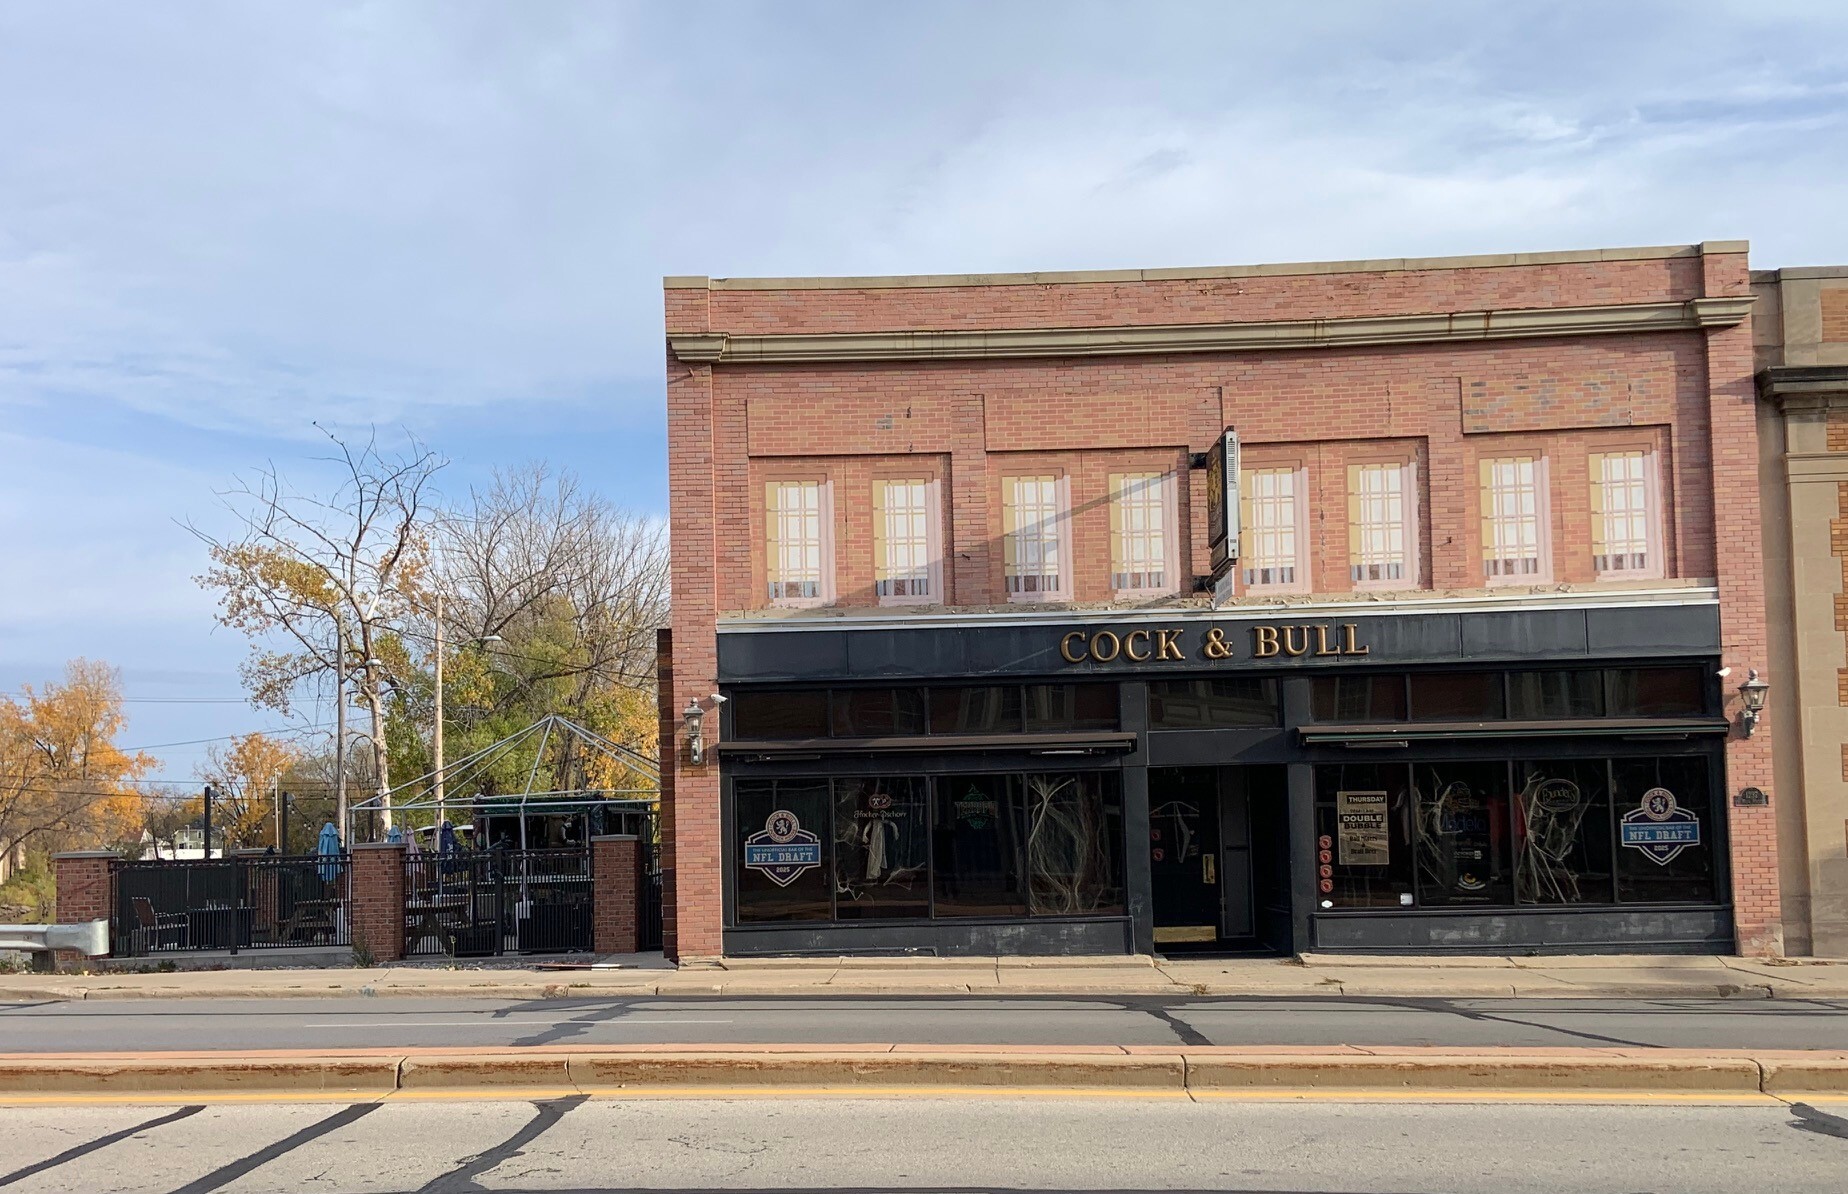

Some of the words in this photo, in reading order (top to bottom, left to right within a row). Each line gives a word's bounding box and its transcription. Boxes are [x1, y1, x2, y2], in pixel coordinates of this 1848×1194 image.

[1060, 628, 1184, 663] COCK
[1203, 628, 1233, 659] &
[1253, 623, 1369, 657] BULL
[1343, 814, 1383, 822] DOUBLE
[1629, 831, 1651, 840] NFL
[1656, 830, 1692, 840] DRAFT
[753, 853, 774, 862] NFL
[778, 852, 813, 862] DRAFT
